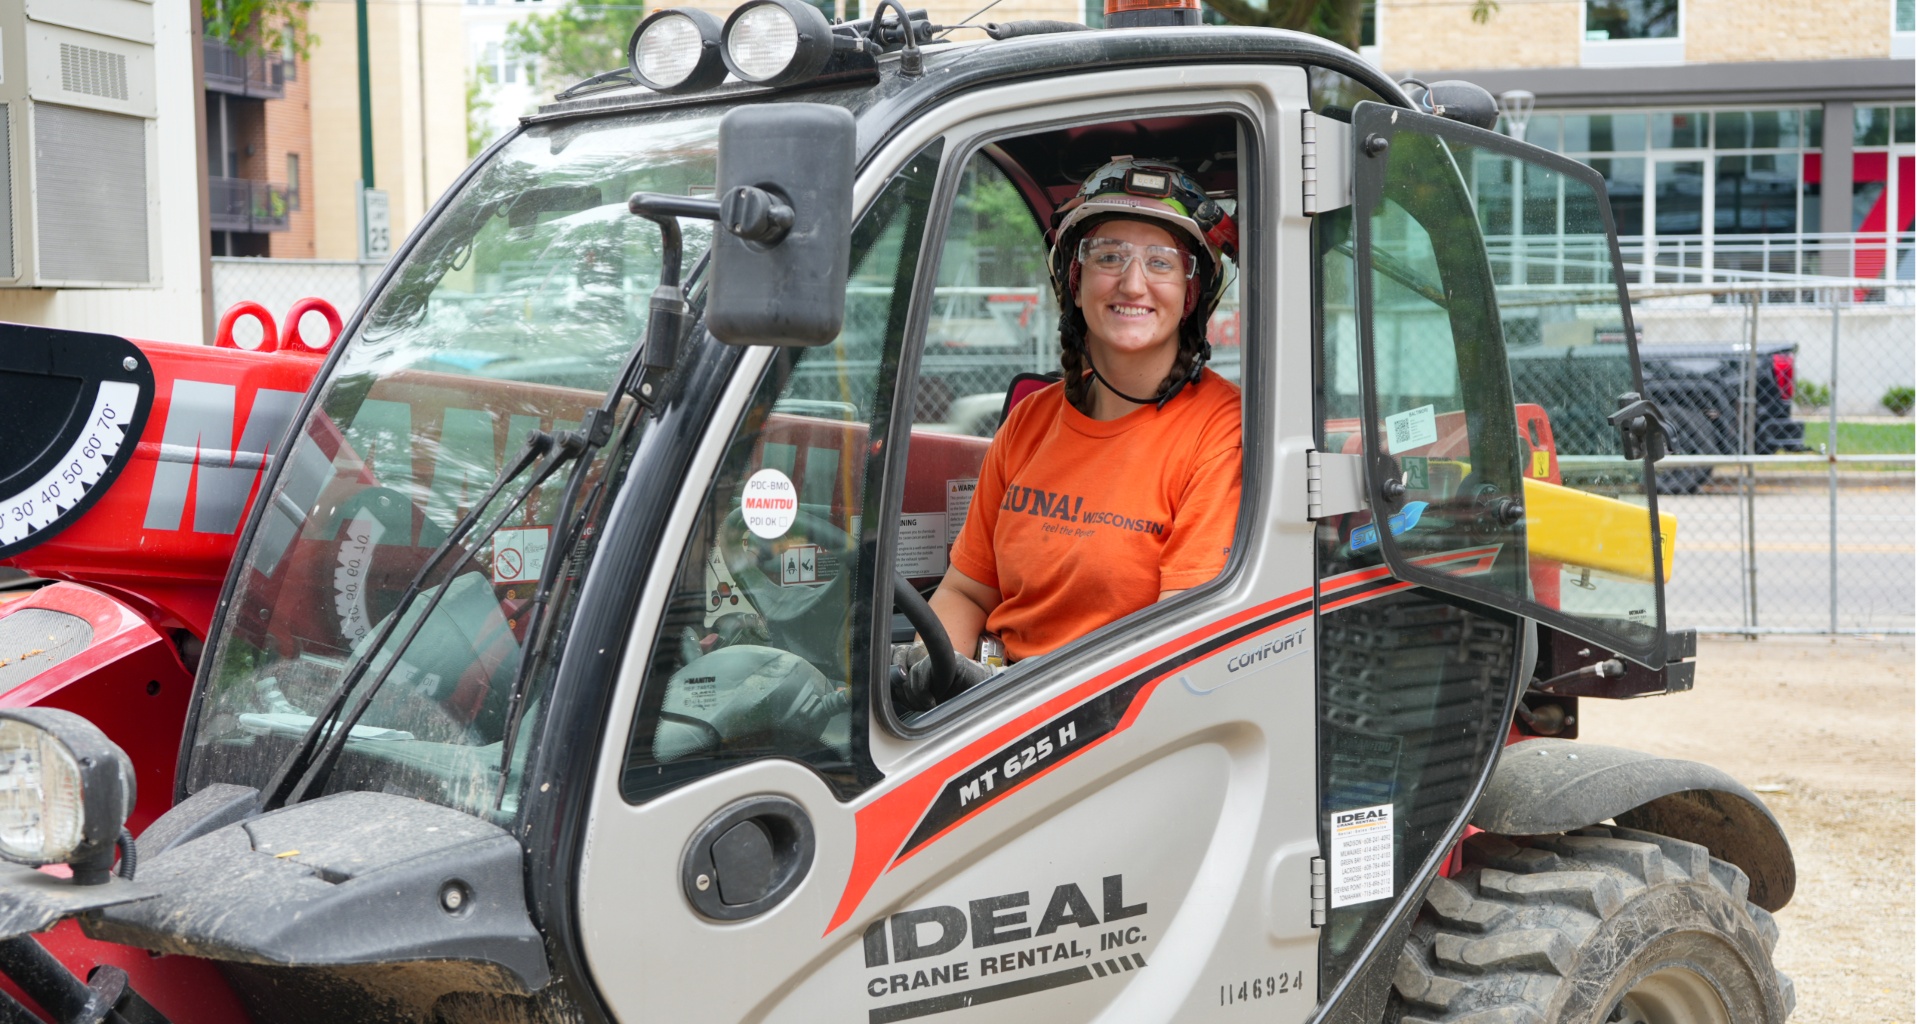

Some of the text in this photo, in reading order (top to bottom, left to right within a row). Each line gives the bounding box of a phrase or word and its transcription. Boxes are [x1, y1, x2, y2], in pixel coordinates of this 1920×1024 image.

[372, 228, 389, 252] 25
[751, 481, 789, 490] PDC-BMO
[746, 498, 793, 510] MANITOU
[1001, 484, 1084, 522] iUNA!
[1082, 512, 1164, 536] WISCONSIN
[750, 516, 776, 526] PDI OK
[1041, 522, 1060, 533] Feel
[1060, 525, 1074, 536] the
[1226, 627, 1307, 674] COMFORT
[958, 720, 1078, 806] MT 625 H
[1337, 809, 1387, 823] IDEAL
[864, 873, 1148, 968] IDEAL
[866, 926, 1148, 998] CRANE RENTAL, INC.
[1220, 970, 1302, 1006] 1146924
